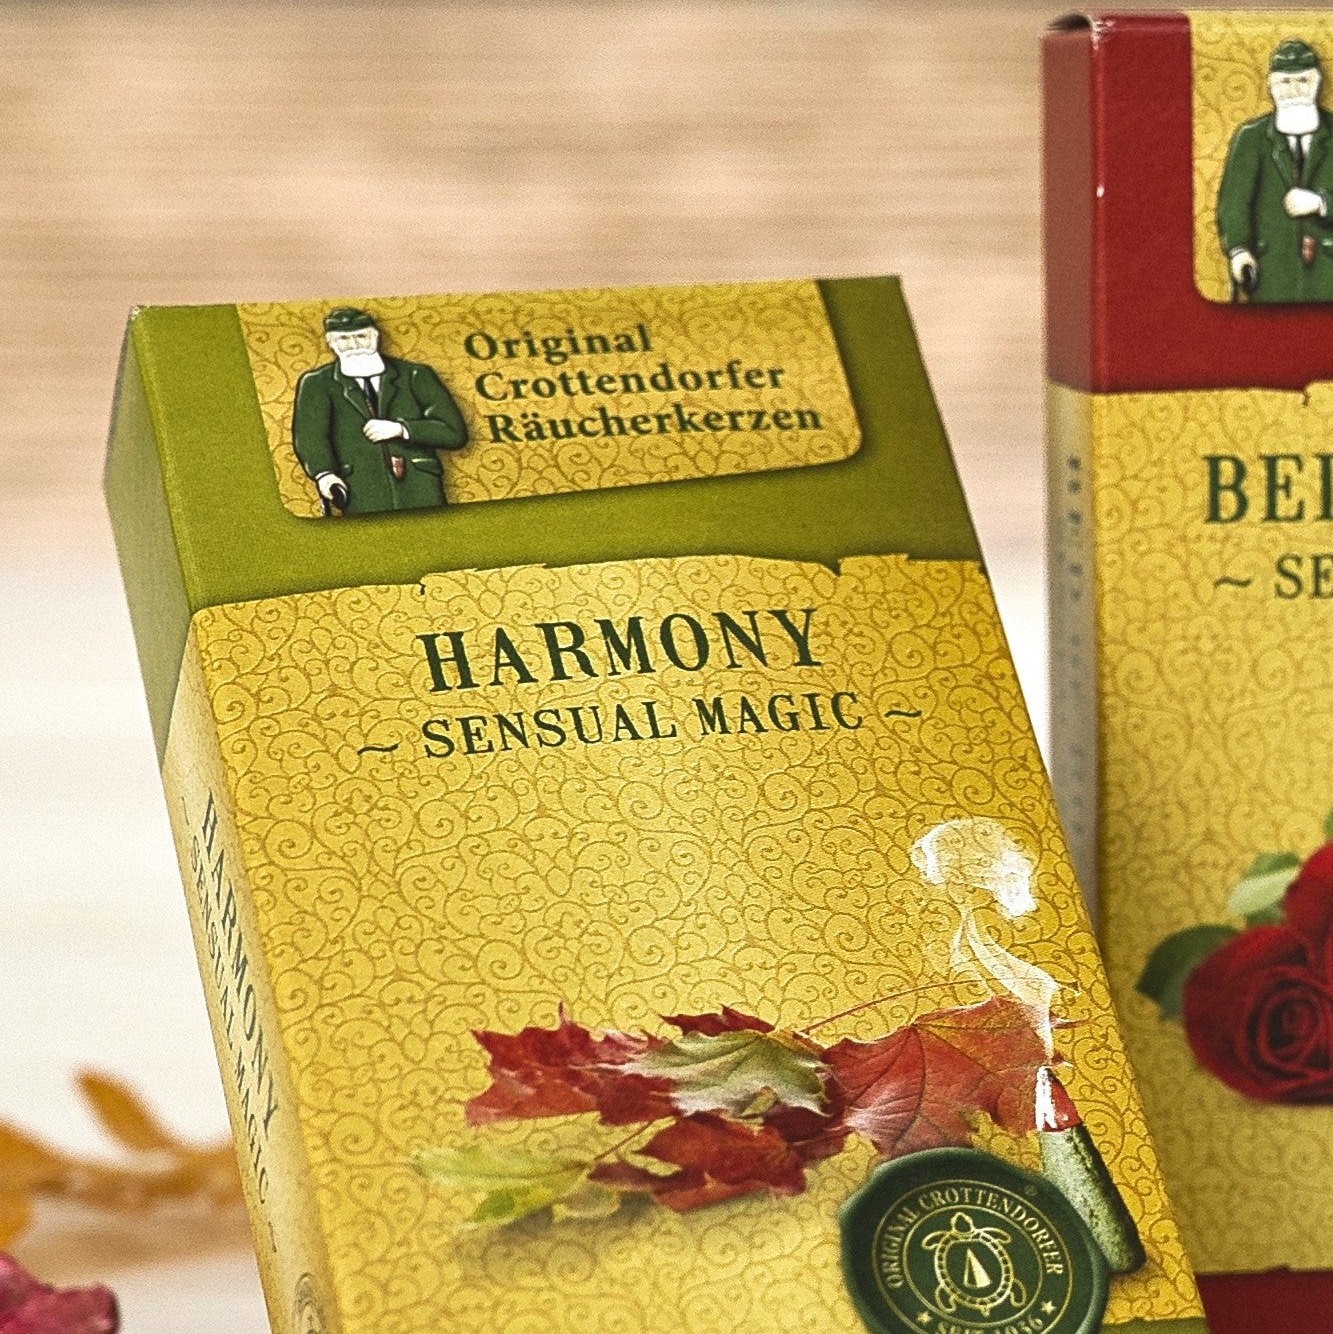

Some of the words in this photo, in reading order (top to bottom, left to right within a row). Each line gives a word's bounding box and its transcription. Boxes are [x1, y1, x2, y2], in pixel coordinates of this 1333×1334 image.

[463, 324, 652, 364] Original
[475, 362, 786, 402] Crottendorfer
[487, 401, 824, 444] Räucherkerzen
[417, 608, 823, 693] HARMONY
[422, 698, 679, 760] SENSUAL
[690, 689, 866, 737] MAGIC
[202, 790, 280, 1141] HARMONY
[191, 834, 235, 1051] SENSUAL
[234, 1049, 270, 1205] MAGIC
[882, 1206, 920, 1289] ORIGINAL
[918, 1187, 1064, 1276] CROTTENDORFER
